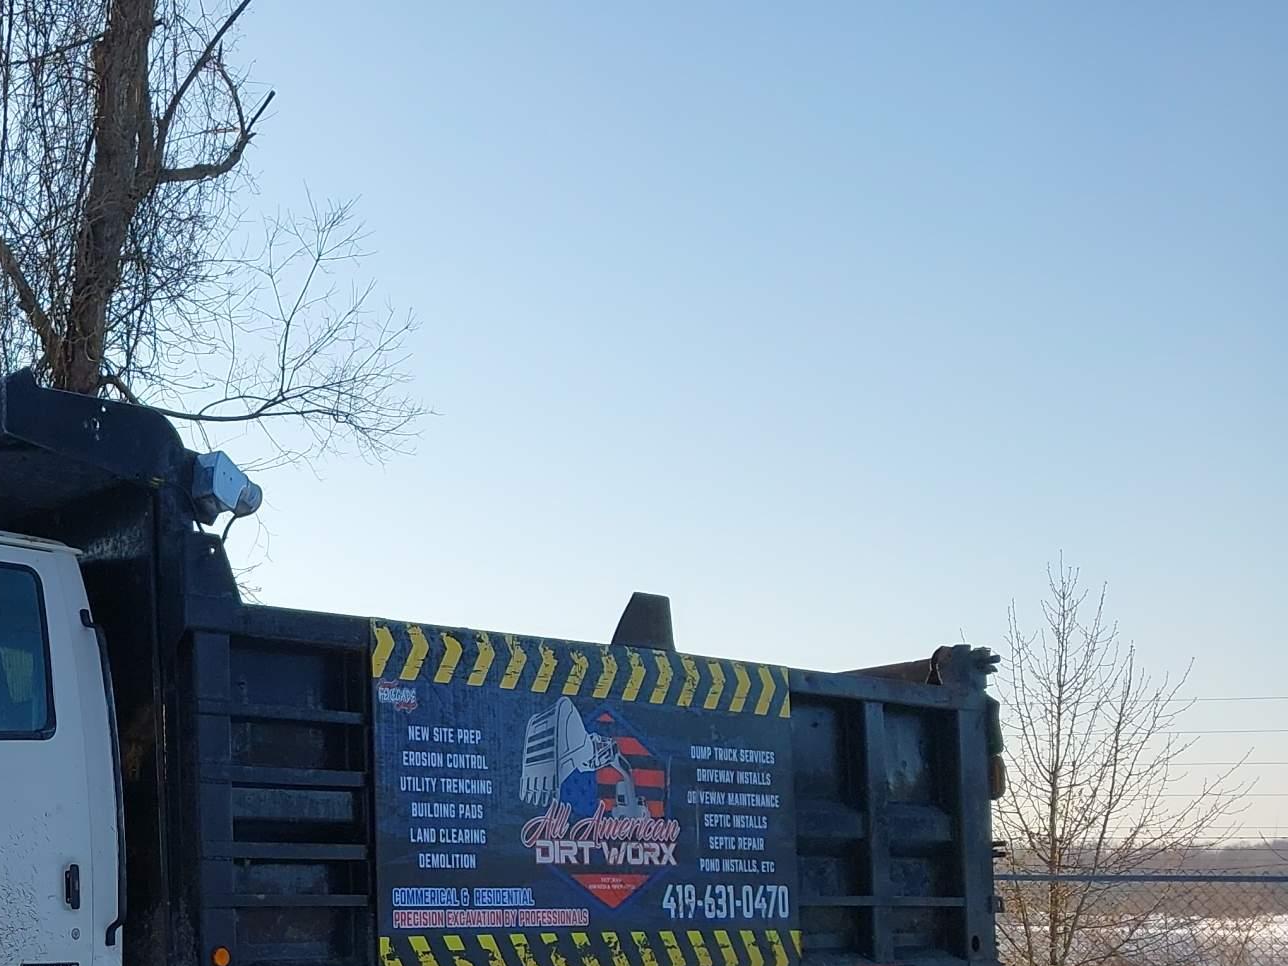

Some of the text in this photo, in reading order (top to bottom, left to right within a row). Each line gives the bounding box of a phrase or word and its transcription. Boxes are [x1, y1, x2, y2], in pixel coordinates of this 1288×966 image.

[408, 725, 482, 744] NEW SITE PREP
[402, 751, 488, 770] EROSION CONTROL
[691, 745, 775, 764] DUMP TRUCK SERVICES
[400, 776, 492, 794] UTILITY TRENCHING
[696, 768, 771, 786] DRIVEWAY INSTALLS
[687, 790, 780, 808] DRVEWAY MAINTENANCE
[412, 803, 483, 819] BUILDING PADS
[521, 798, 680, 849] All American
[704, 813, 768, 829] SEPTIC INSTALLS
[410, 827, 486, 845] LAND CLEARING
[709, 836, 765, 851] SEPTIC REPAIR
[419, 854, 476, 869] DEMOLITION
[536, 840, 677, 865] DIRT WORX
[700, 858, 775, 874] POND INSTALLS, ETC
[392, 887, 535, 907] COMMERICAL & RESIDENTIAL
[662, 883, 789, 920] 419-631-0470
[393, 908, 589, 928] PRECISION EXCAVATION BY PROFESSIONALS
